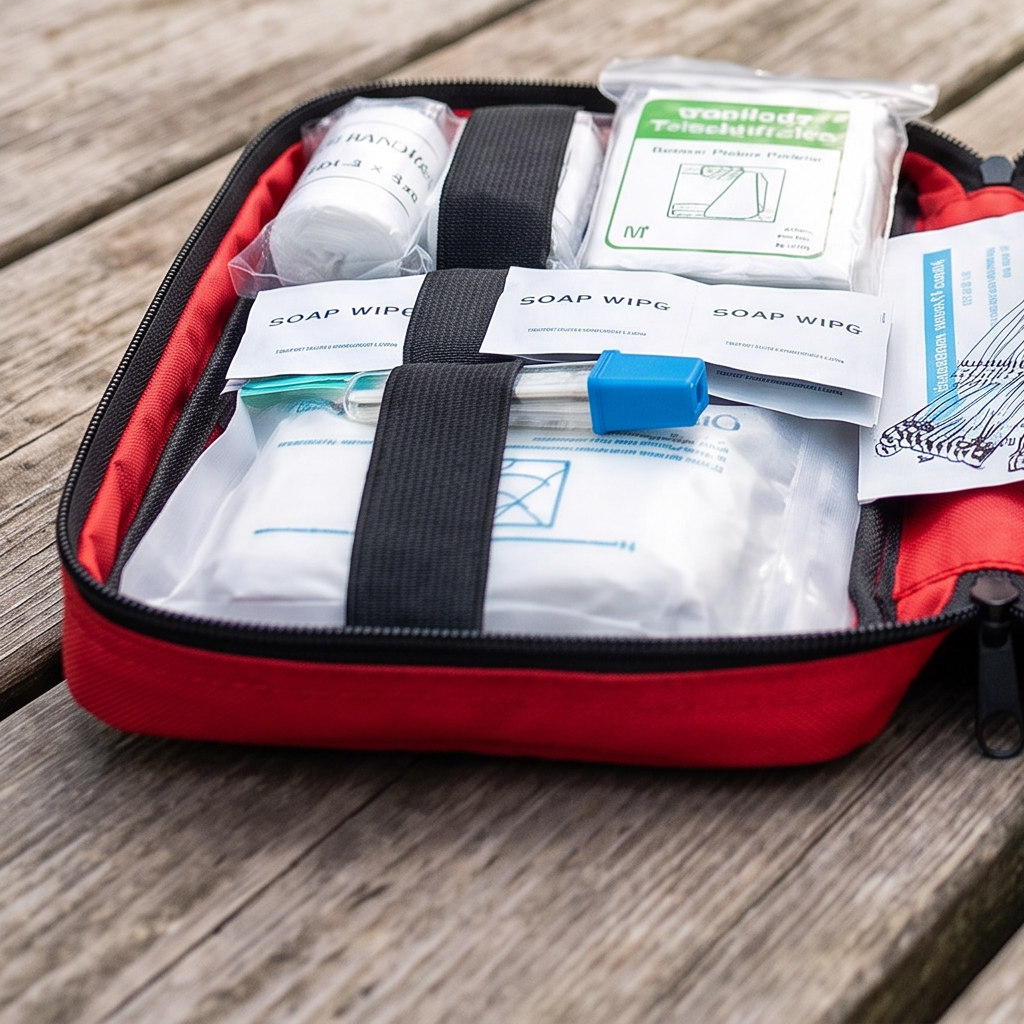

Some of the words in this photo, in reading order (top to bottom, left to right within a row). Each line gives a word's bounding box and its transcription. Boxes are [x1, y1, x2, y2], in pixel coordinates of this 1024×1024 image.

[519, 294, 592, 306] SOAP
[603, 295, 671, 311] WIPG
[269, 308, 340, 327] SOAP
[713, 308, 785, 321] SOAP
[796, 315, 863, 335] WIPG
